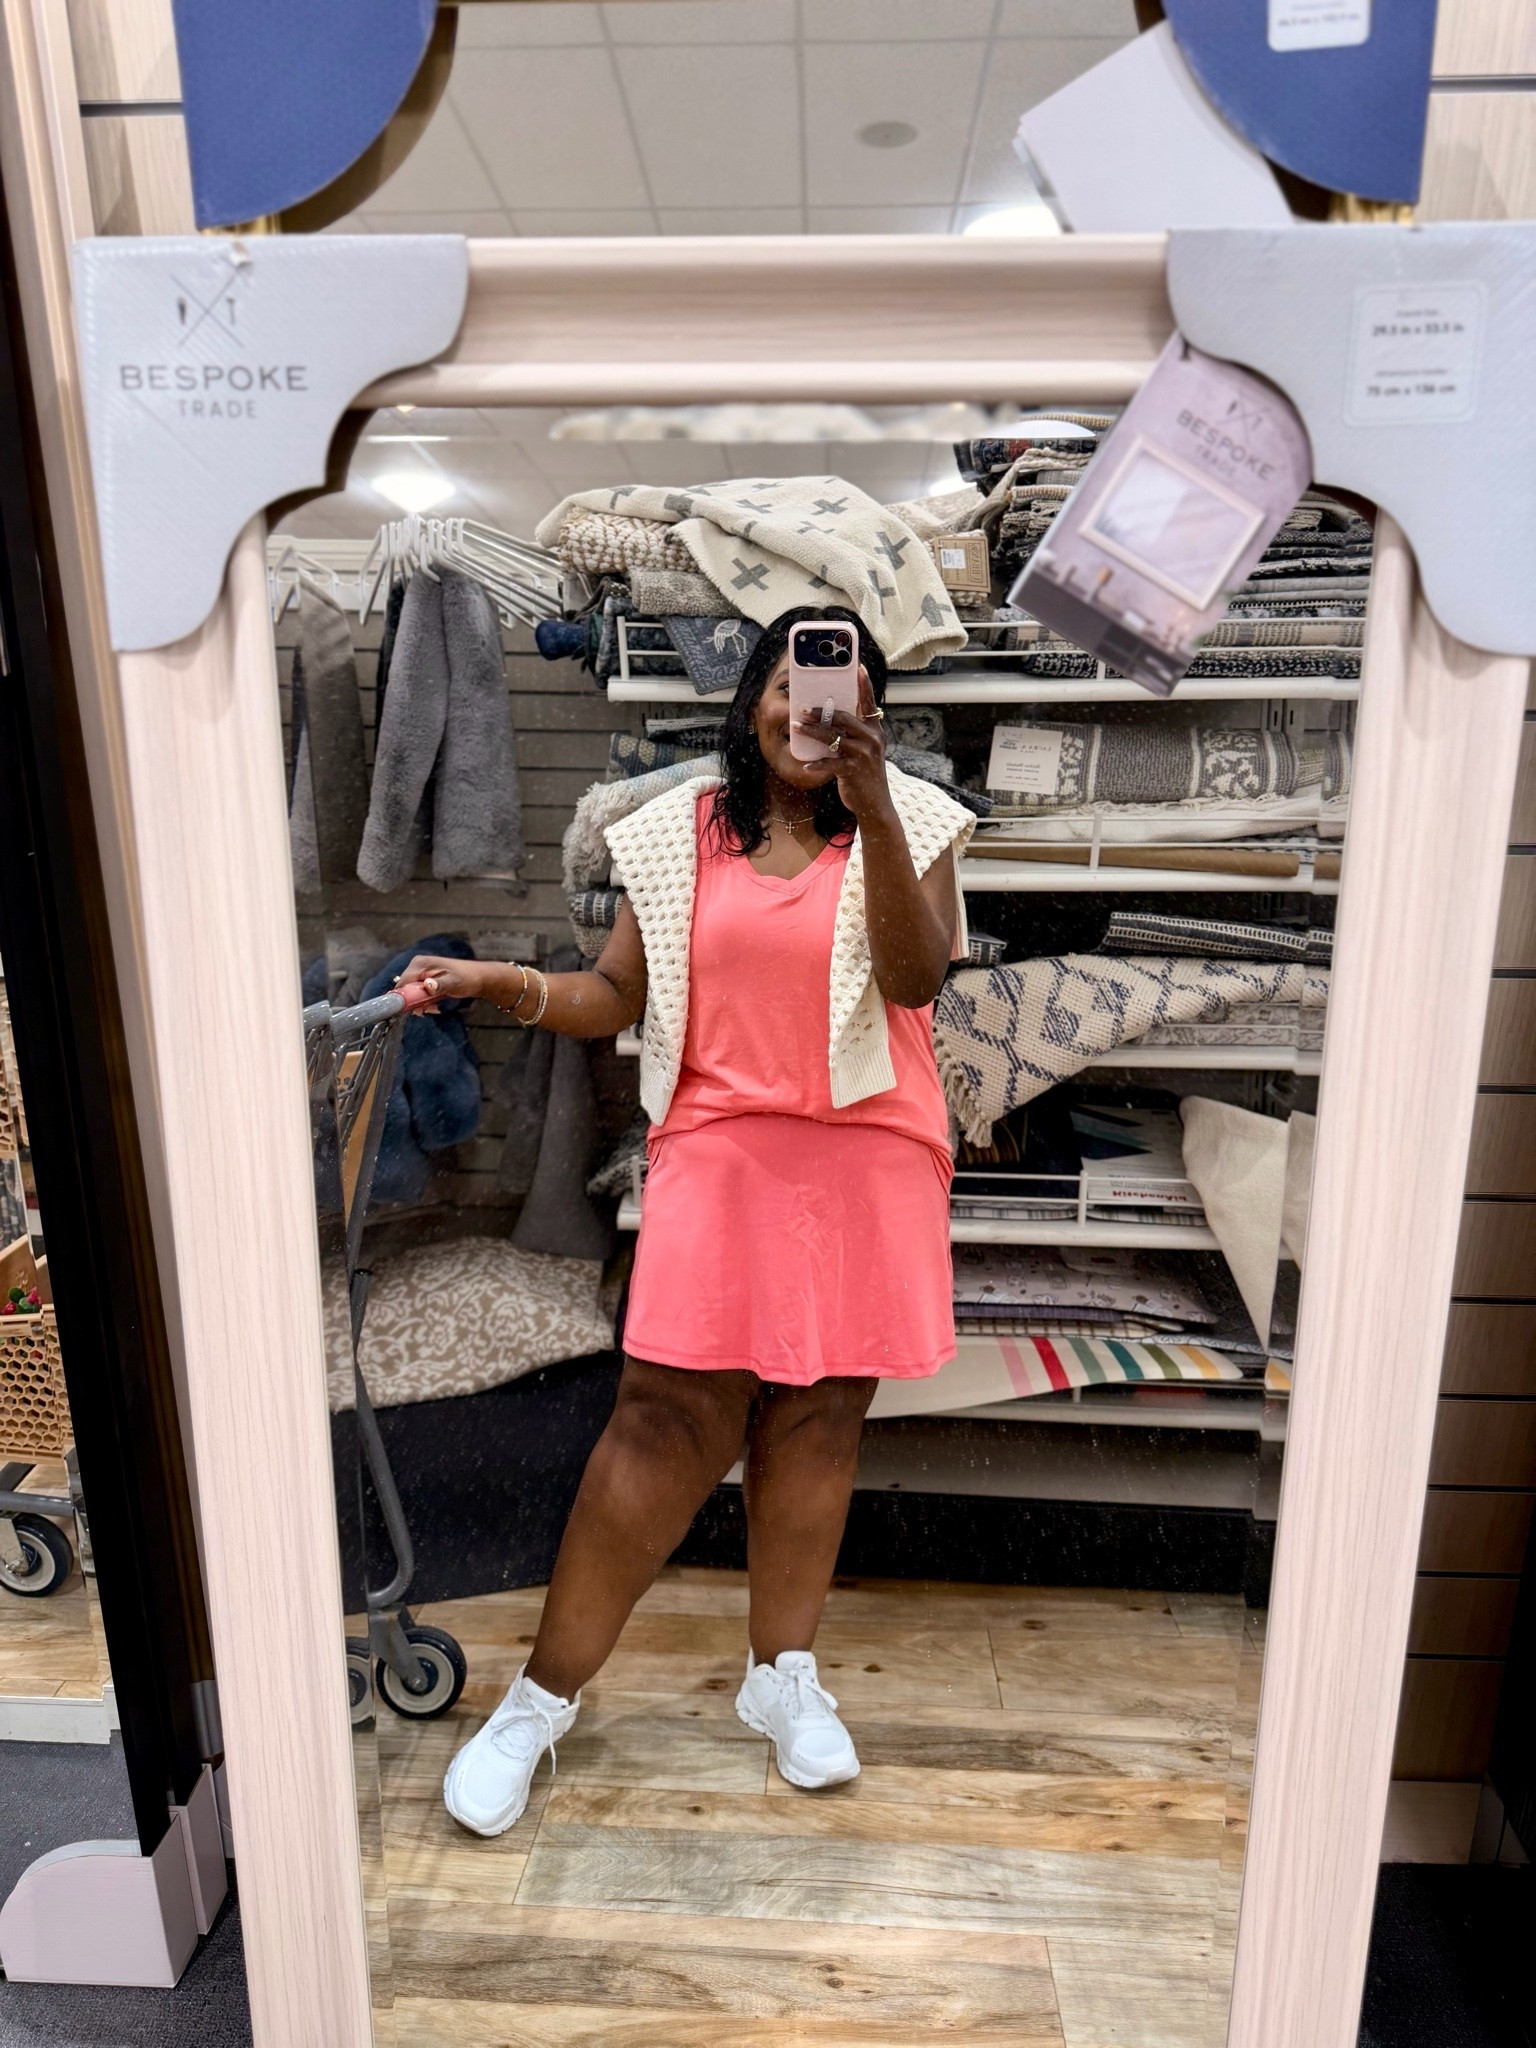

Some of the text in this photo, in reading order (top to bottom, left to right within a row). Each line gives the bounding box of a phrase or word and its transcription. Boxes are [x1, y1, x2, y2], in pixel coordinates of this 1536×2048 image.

[119, 364, 309, 392] BESPOKE
[178, 399, 258, 420] TRADE
[1176, 408, 1276, 482] BESPOKE
